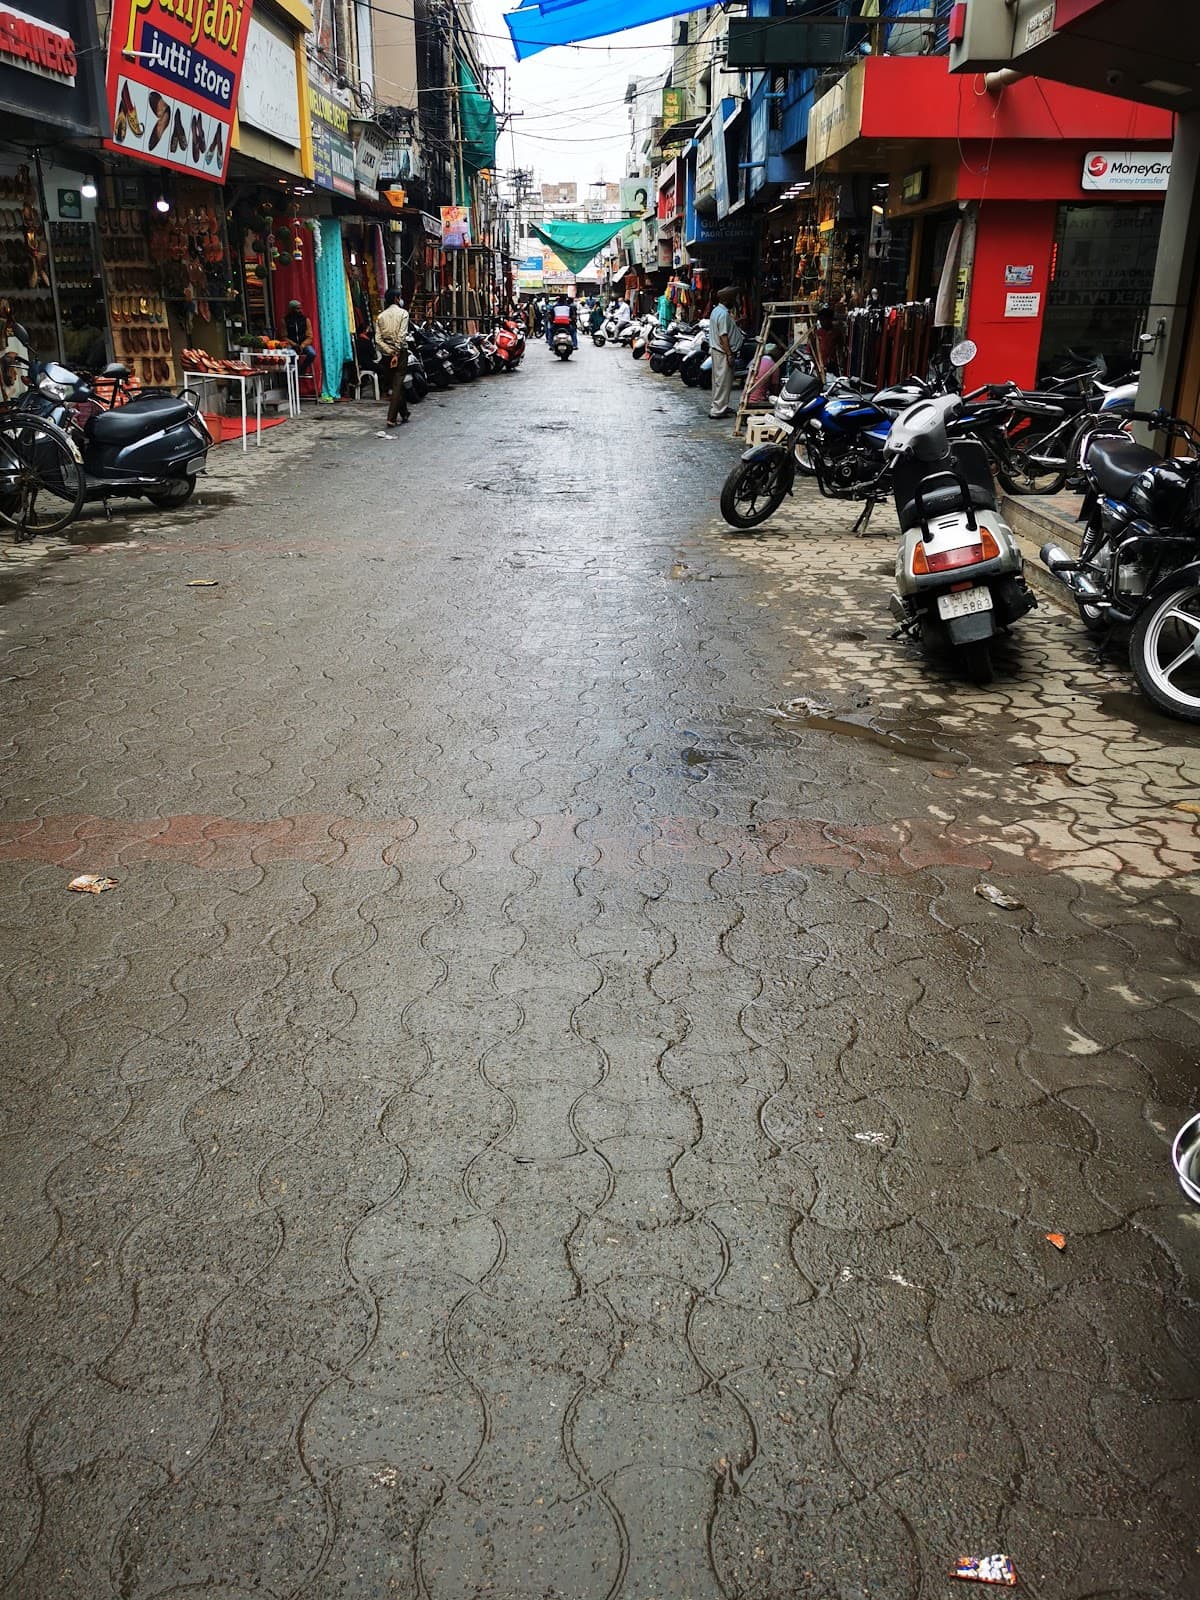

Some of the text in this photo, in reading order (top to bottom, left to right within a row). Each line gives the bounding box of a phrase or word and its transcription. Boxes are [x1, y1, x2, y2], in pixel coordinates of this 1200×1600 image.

[148, 31, 231, 100] jutti store
[1134, 177, 1164, 185] transfer
